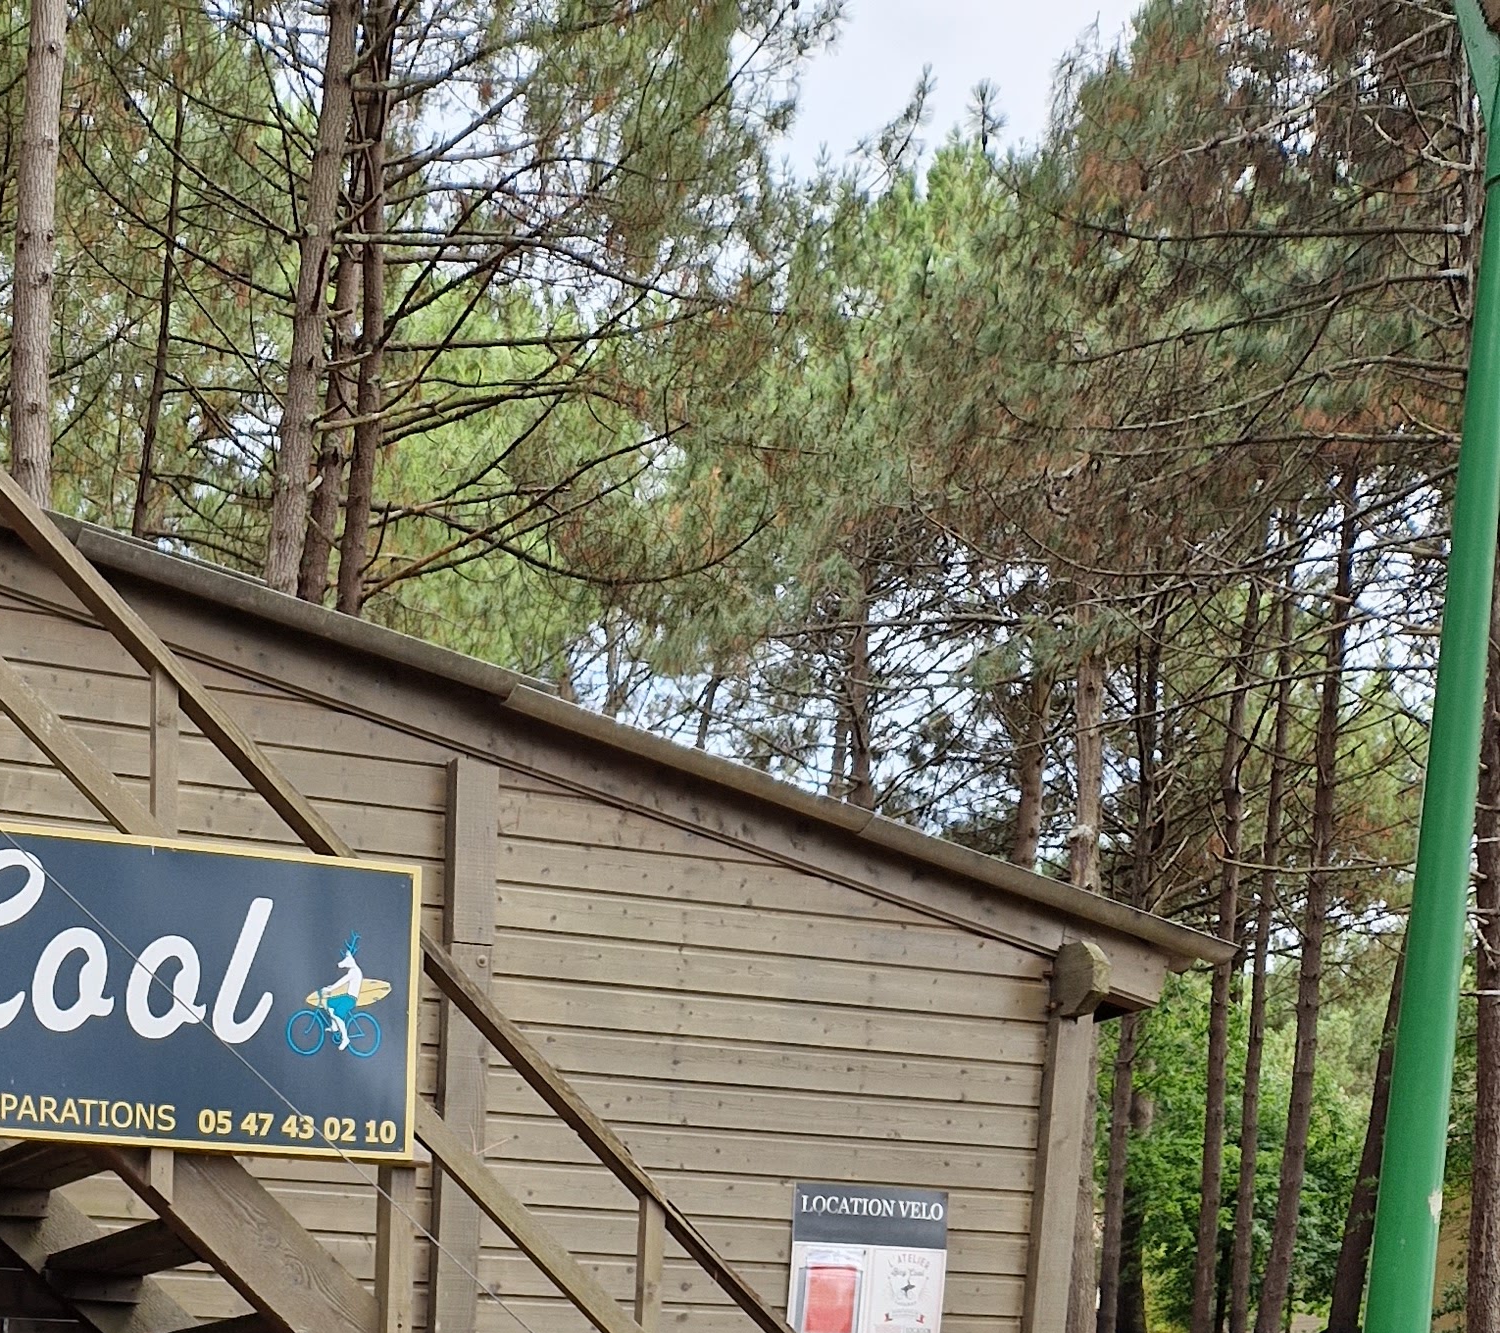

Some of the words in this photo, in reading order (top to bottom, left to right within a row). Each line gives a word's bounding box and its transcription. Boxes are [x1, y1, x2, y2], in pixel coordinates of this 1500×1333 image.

[198, 1108, 232, 1135] 05
[240, 1112, 274, 1138] 47
[281, 1115, 315, 1139] 43
[323, 1117, 357, 1142] 02
[364, 1120, 397, 1144] 10
[801, 1195, 895, 1217] LOCATION
[900, 1201, 944, 1221] VELO
